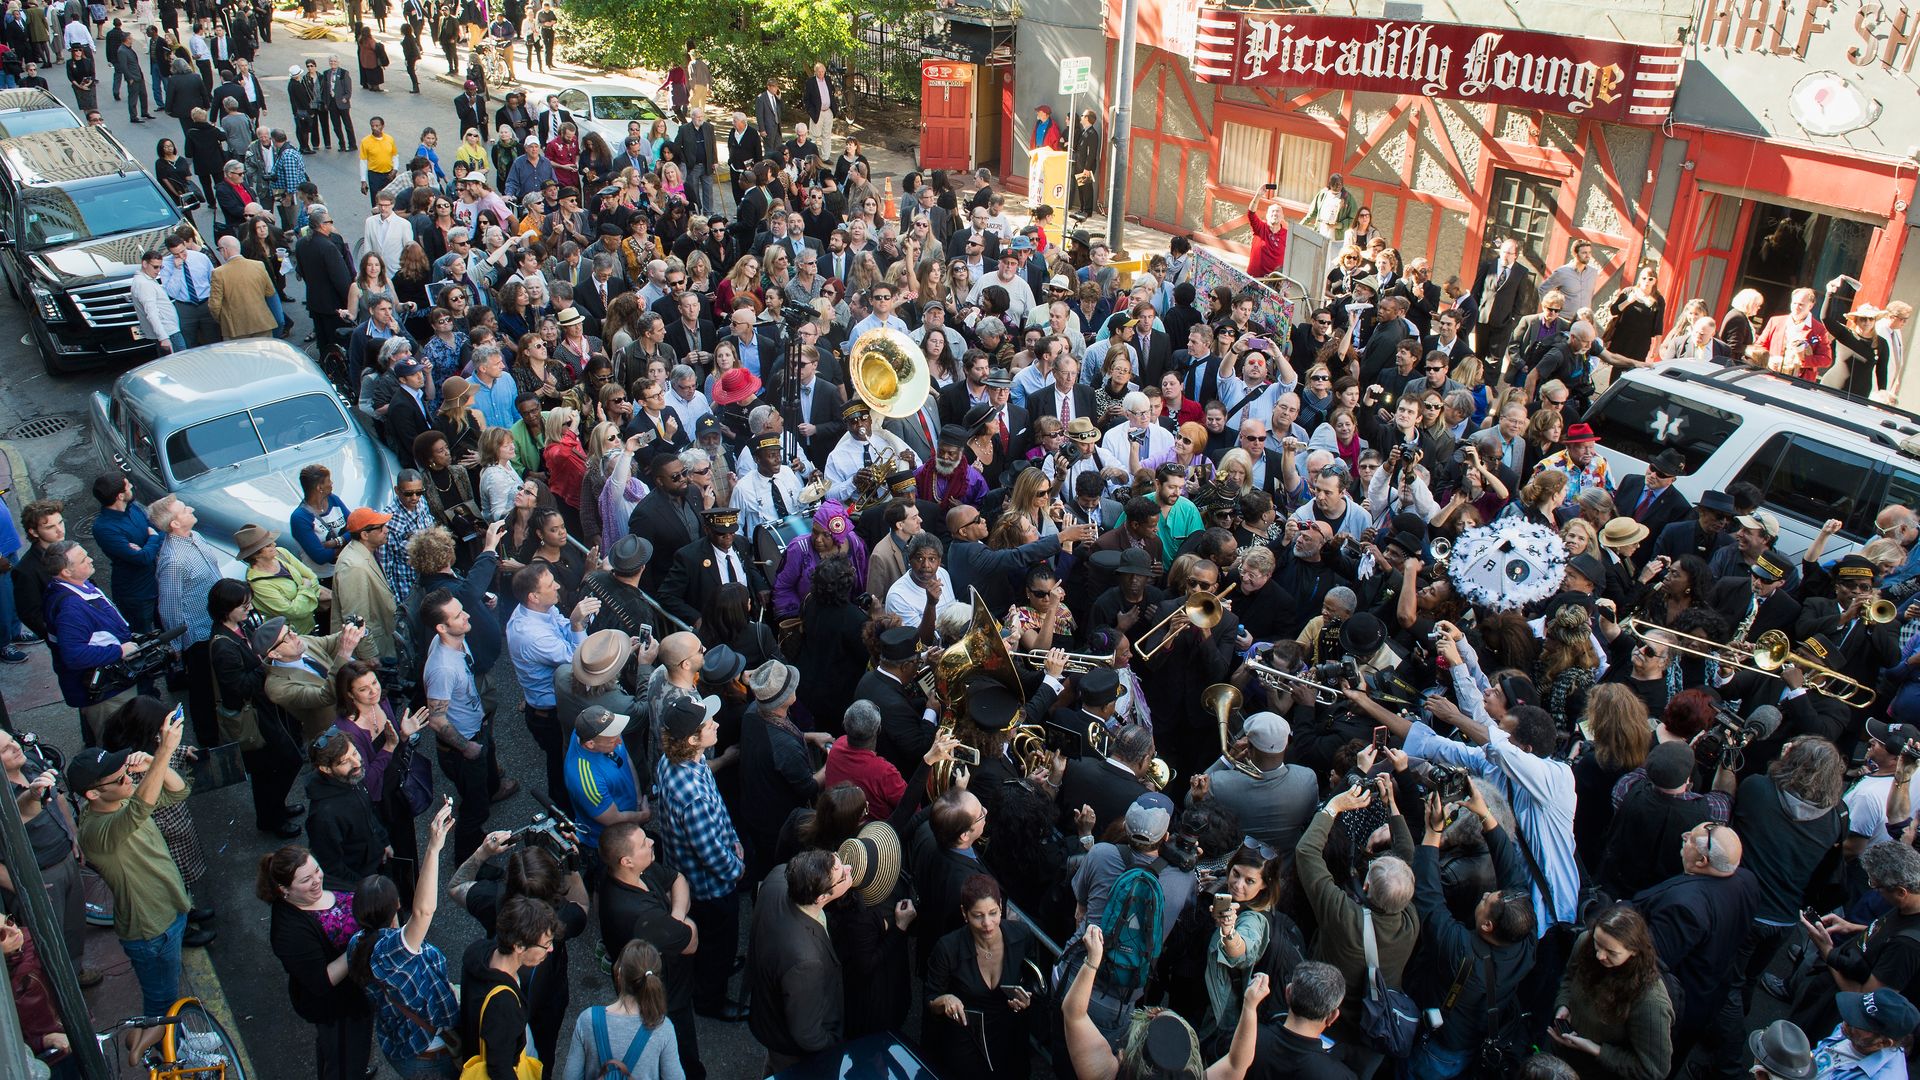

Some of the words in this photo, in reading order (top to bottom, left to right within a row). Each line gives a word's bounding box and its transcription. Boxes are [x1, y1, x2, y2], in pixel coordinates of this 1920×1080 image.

[1700, 0, 1830, 58] HALF
[928, 66, 966, 78] SPA
[1245, 17, 1452, 97] Piccadilly
[1458, 32, 1627, 114] Lounge
